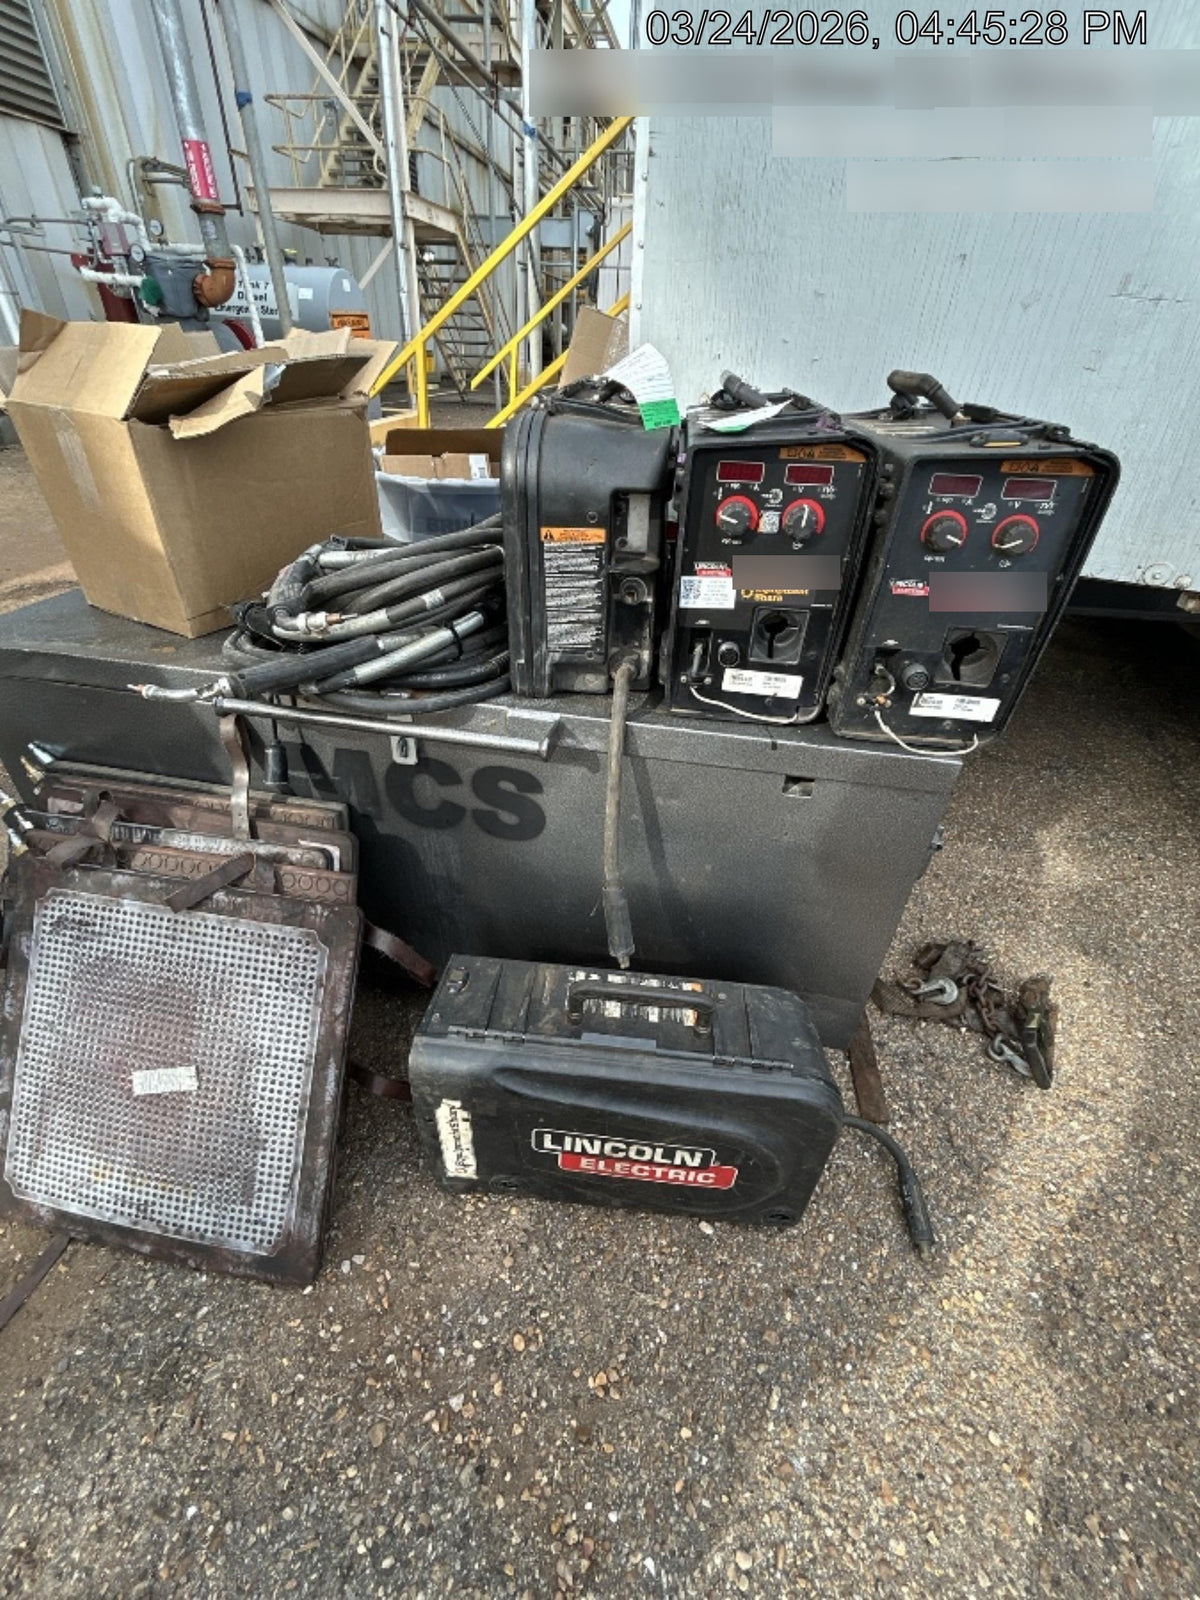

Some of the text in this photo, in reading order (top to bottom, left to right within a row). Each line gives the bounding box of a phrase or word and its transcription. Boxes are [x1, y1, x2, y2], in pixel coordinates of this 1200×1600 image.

[237, 280, 261, 290] Tnk
[543, 1133, 703, 1167] LINCOLN
[580, 1159, 717, 1184] ELECTRIC
